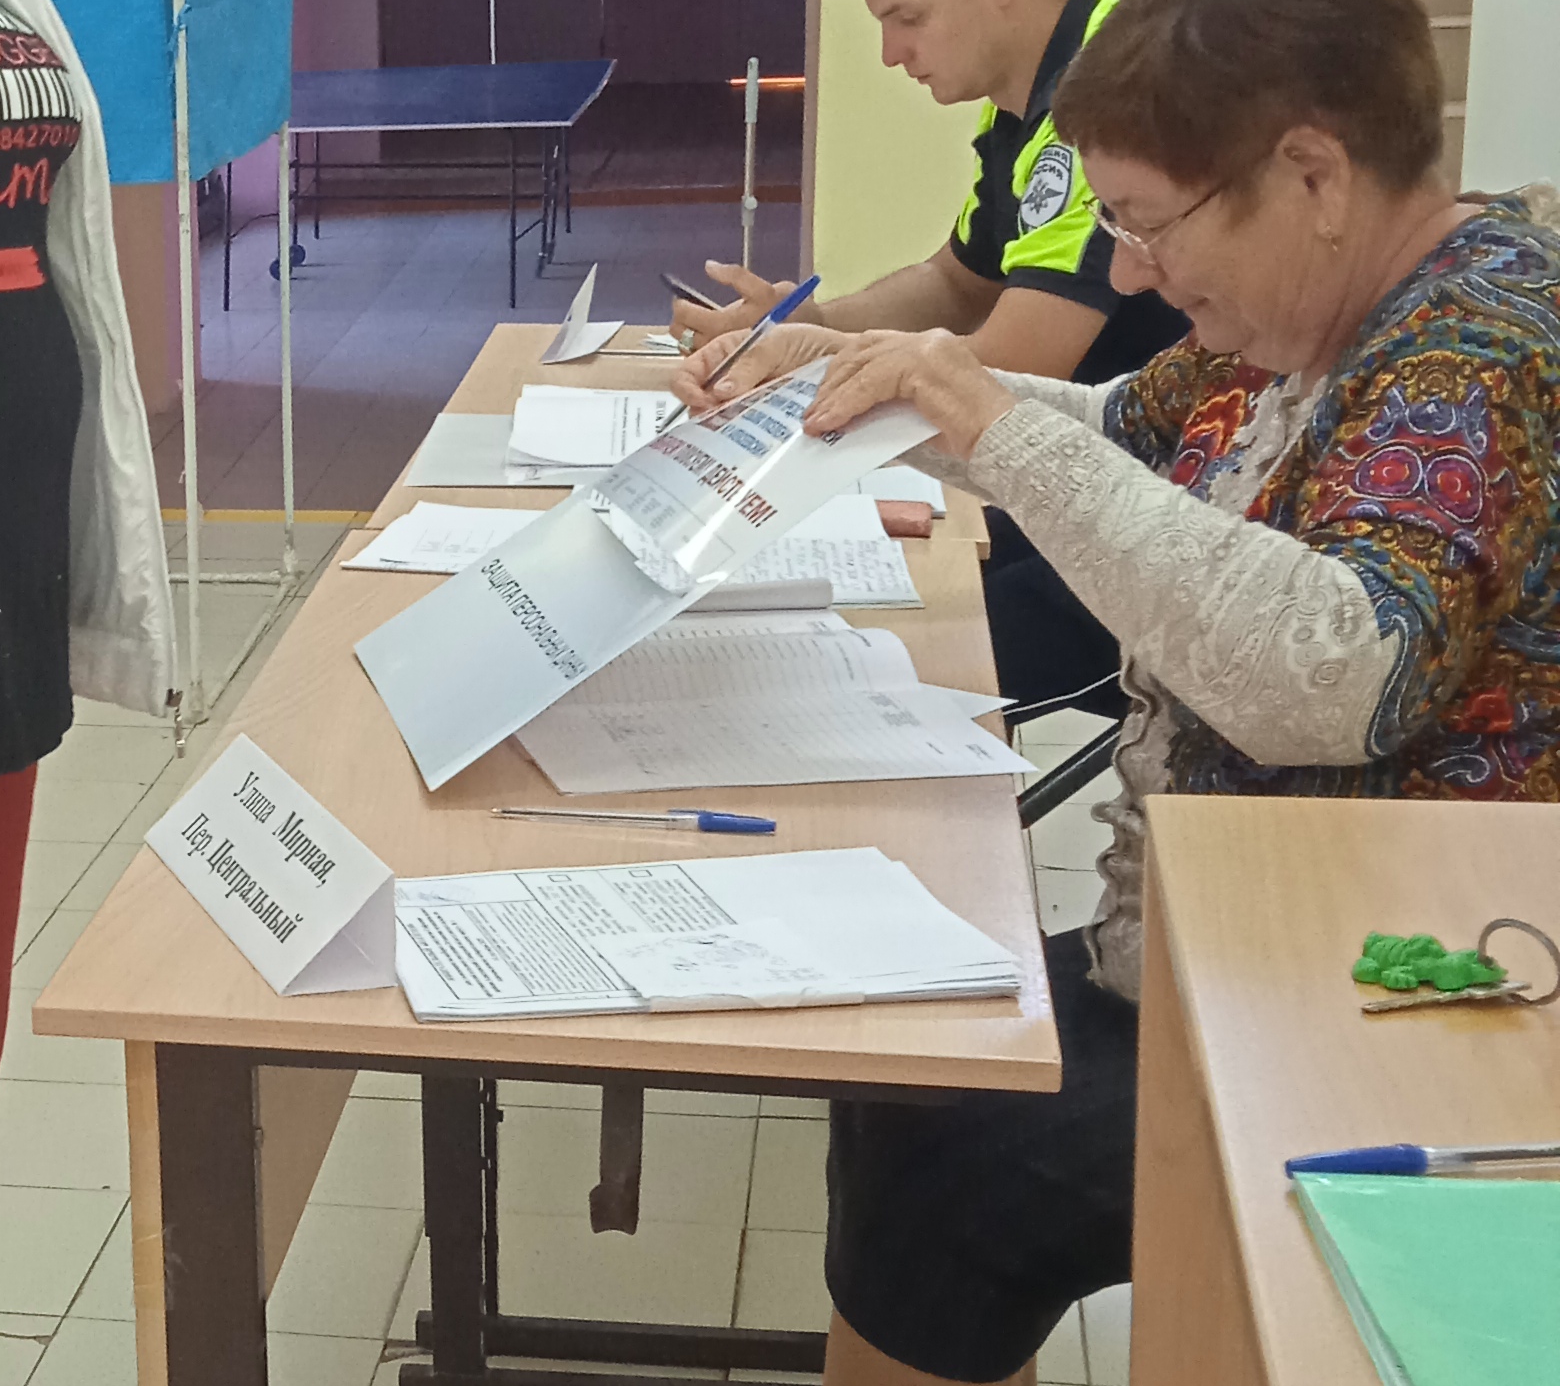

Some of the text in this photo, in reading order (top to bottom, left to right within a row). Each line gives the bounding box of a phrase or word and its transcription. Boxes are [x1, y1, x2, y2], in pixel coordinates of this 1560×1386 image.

[181, 812, 304, 944] Пер. Центральный
[233, 771, 336, 889] Улица Мирная,
